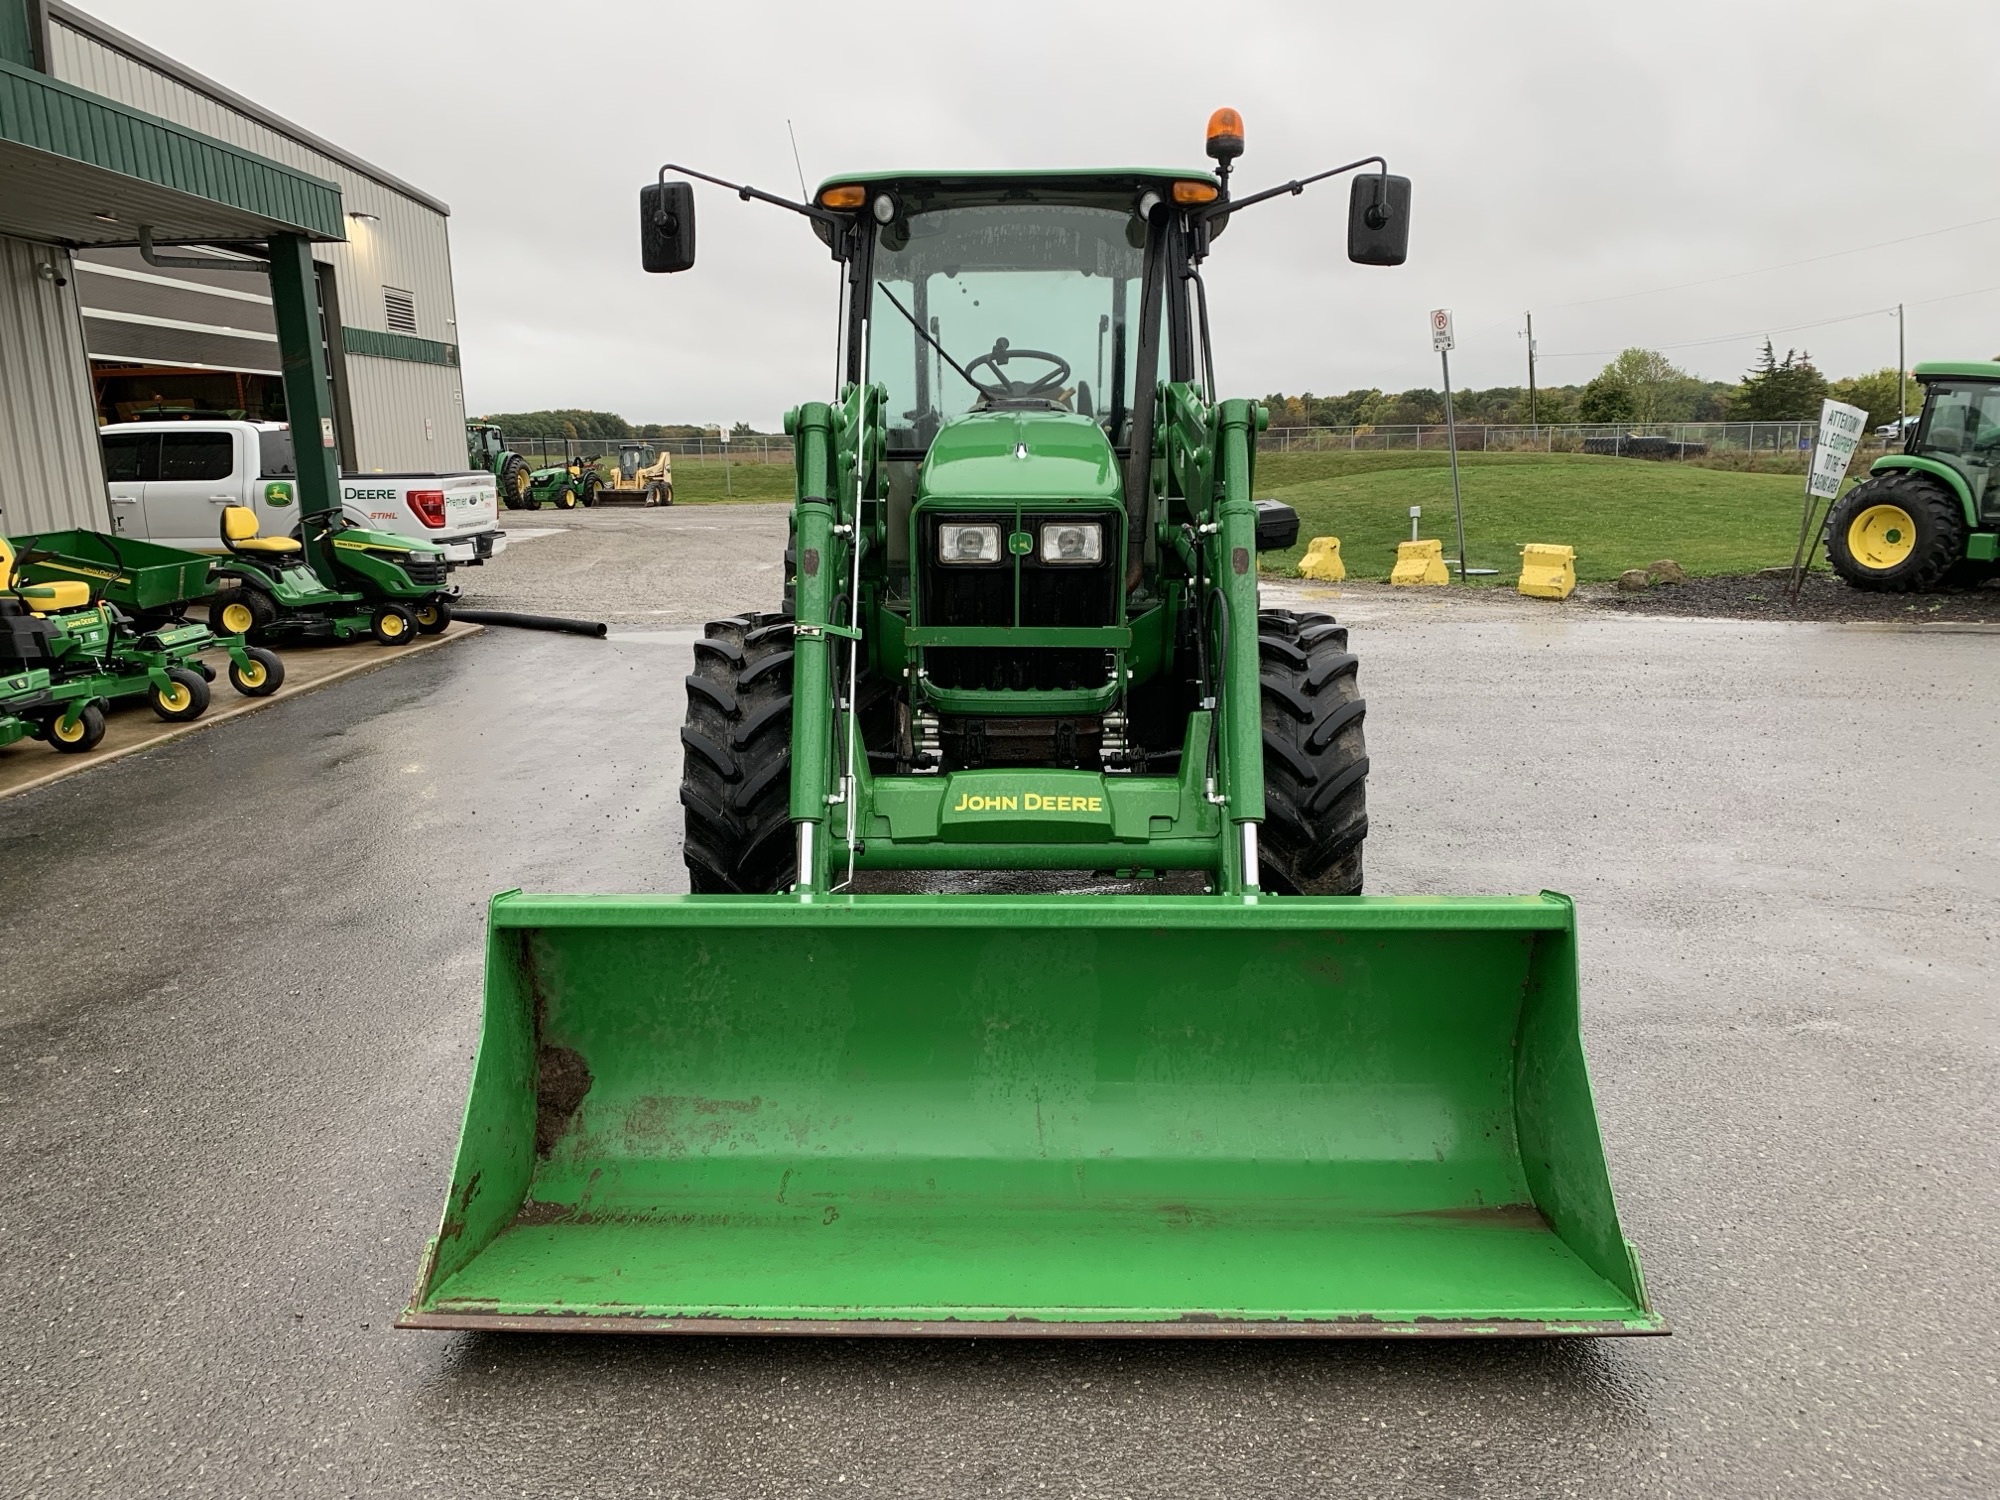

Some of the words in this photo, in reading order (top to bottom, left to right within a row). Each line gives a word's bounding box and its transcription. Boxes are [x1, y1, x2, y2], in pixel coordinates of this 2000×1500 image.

[1434, 336, 1451, 344] ROUTE
[344, 487, 397, 500] DEERE
[369, 512, 398, 520] STIHL
[82, 566, 99, 575] JOHN
[66, 620, 81, 629] JOHN
[80, 616, 99, 626] DEERE
[954, 793, 1018, 812] JOHN
[1024, 793, 1103, 812] DEERE
